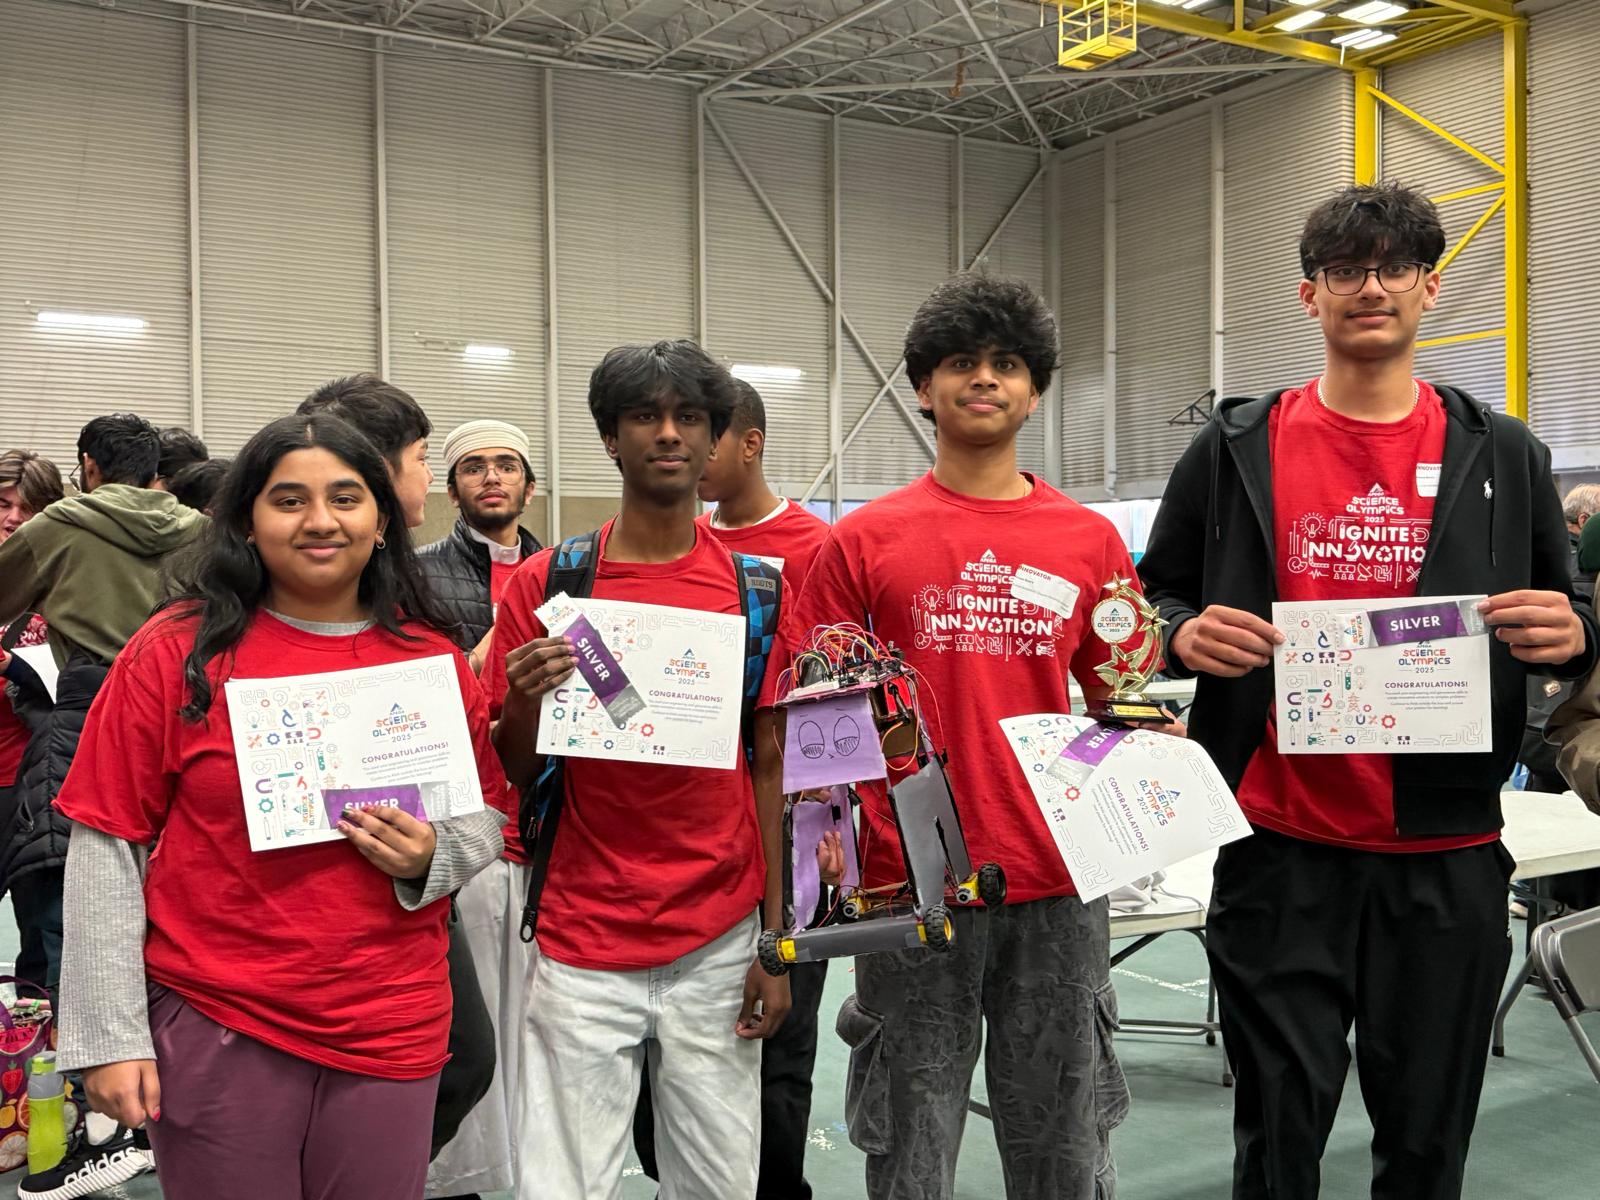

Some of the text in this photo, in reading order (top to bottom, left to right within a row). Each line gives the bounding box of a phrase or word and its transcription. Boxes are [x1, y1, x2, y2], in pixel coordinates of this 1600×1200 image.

[1339, 522, 1409, 542] IGNITE
[977, 584, 997, 593] 2025
[956, 591, 1018, 614] IGNITE
[1390, 615, 1441, 631] SILVER
[577, 637, 610, 682] SILVER
[678, 677, 695, 686] 2025
[1384, 681, 1469, 689] CONGRATULATIONS!
[648, 689, 723, 703] CONGRATULATIONS!
[391, 733, 412, 743] 2025
[1086, 727, 1118, 749] ILVER
[361, 741, 449, 764] CONGRATULATIONS!
[1108, 776, 1150, 852] CONGRATULATIONS!
[1137, 798, 1151, 815] 2025
[64, 1146, 137, 1186] adidas
